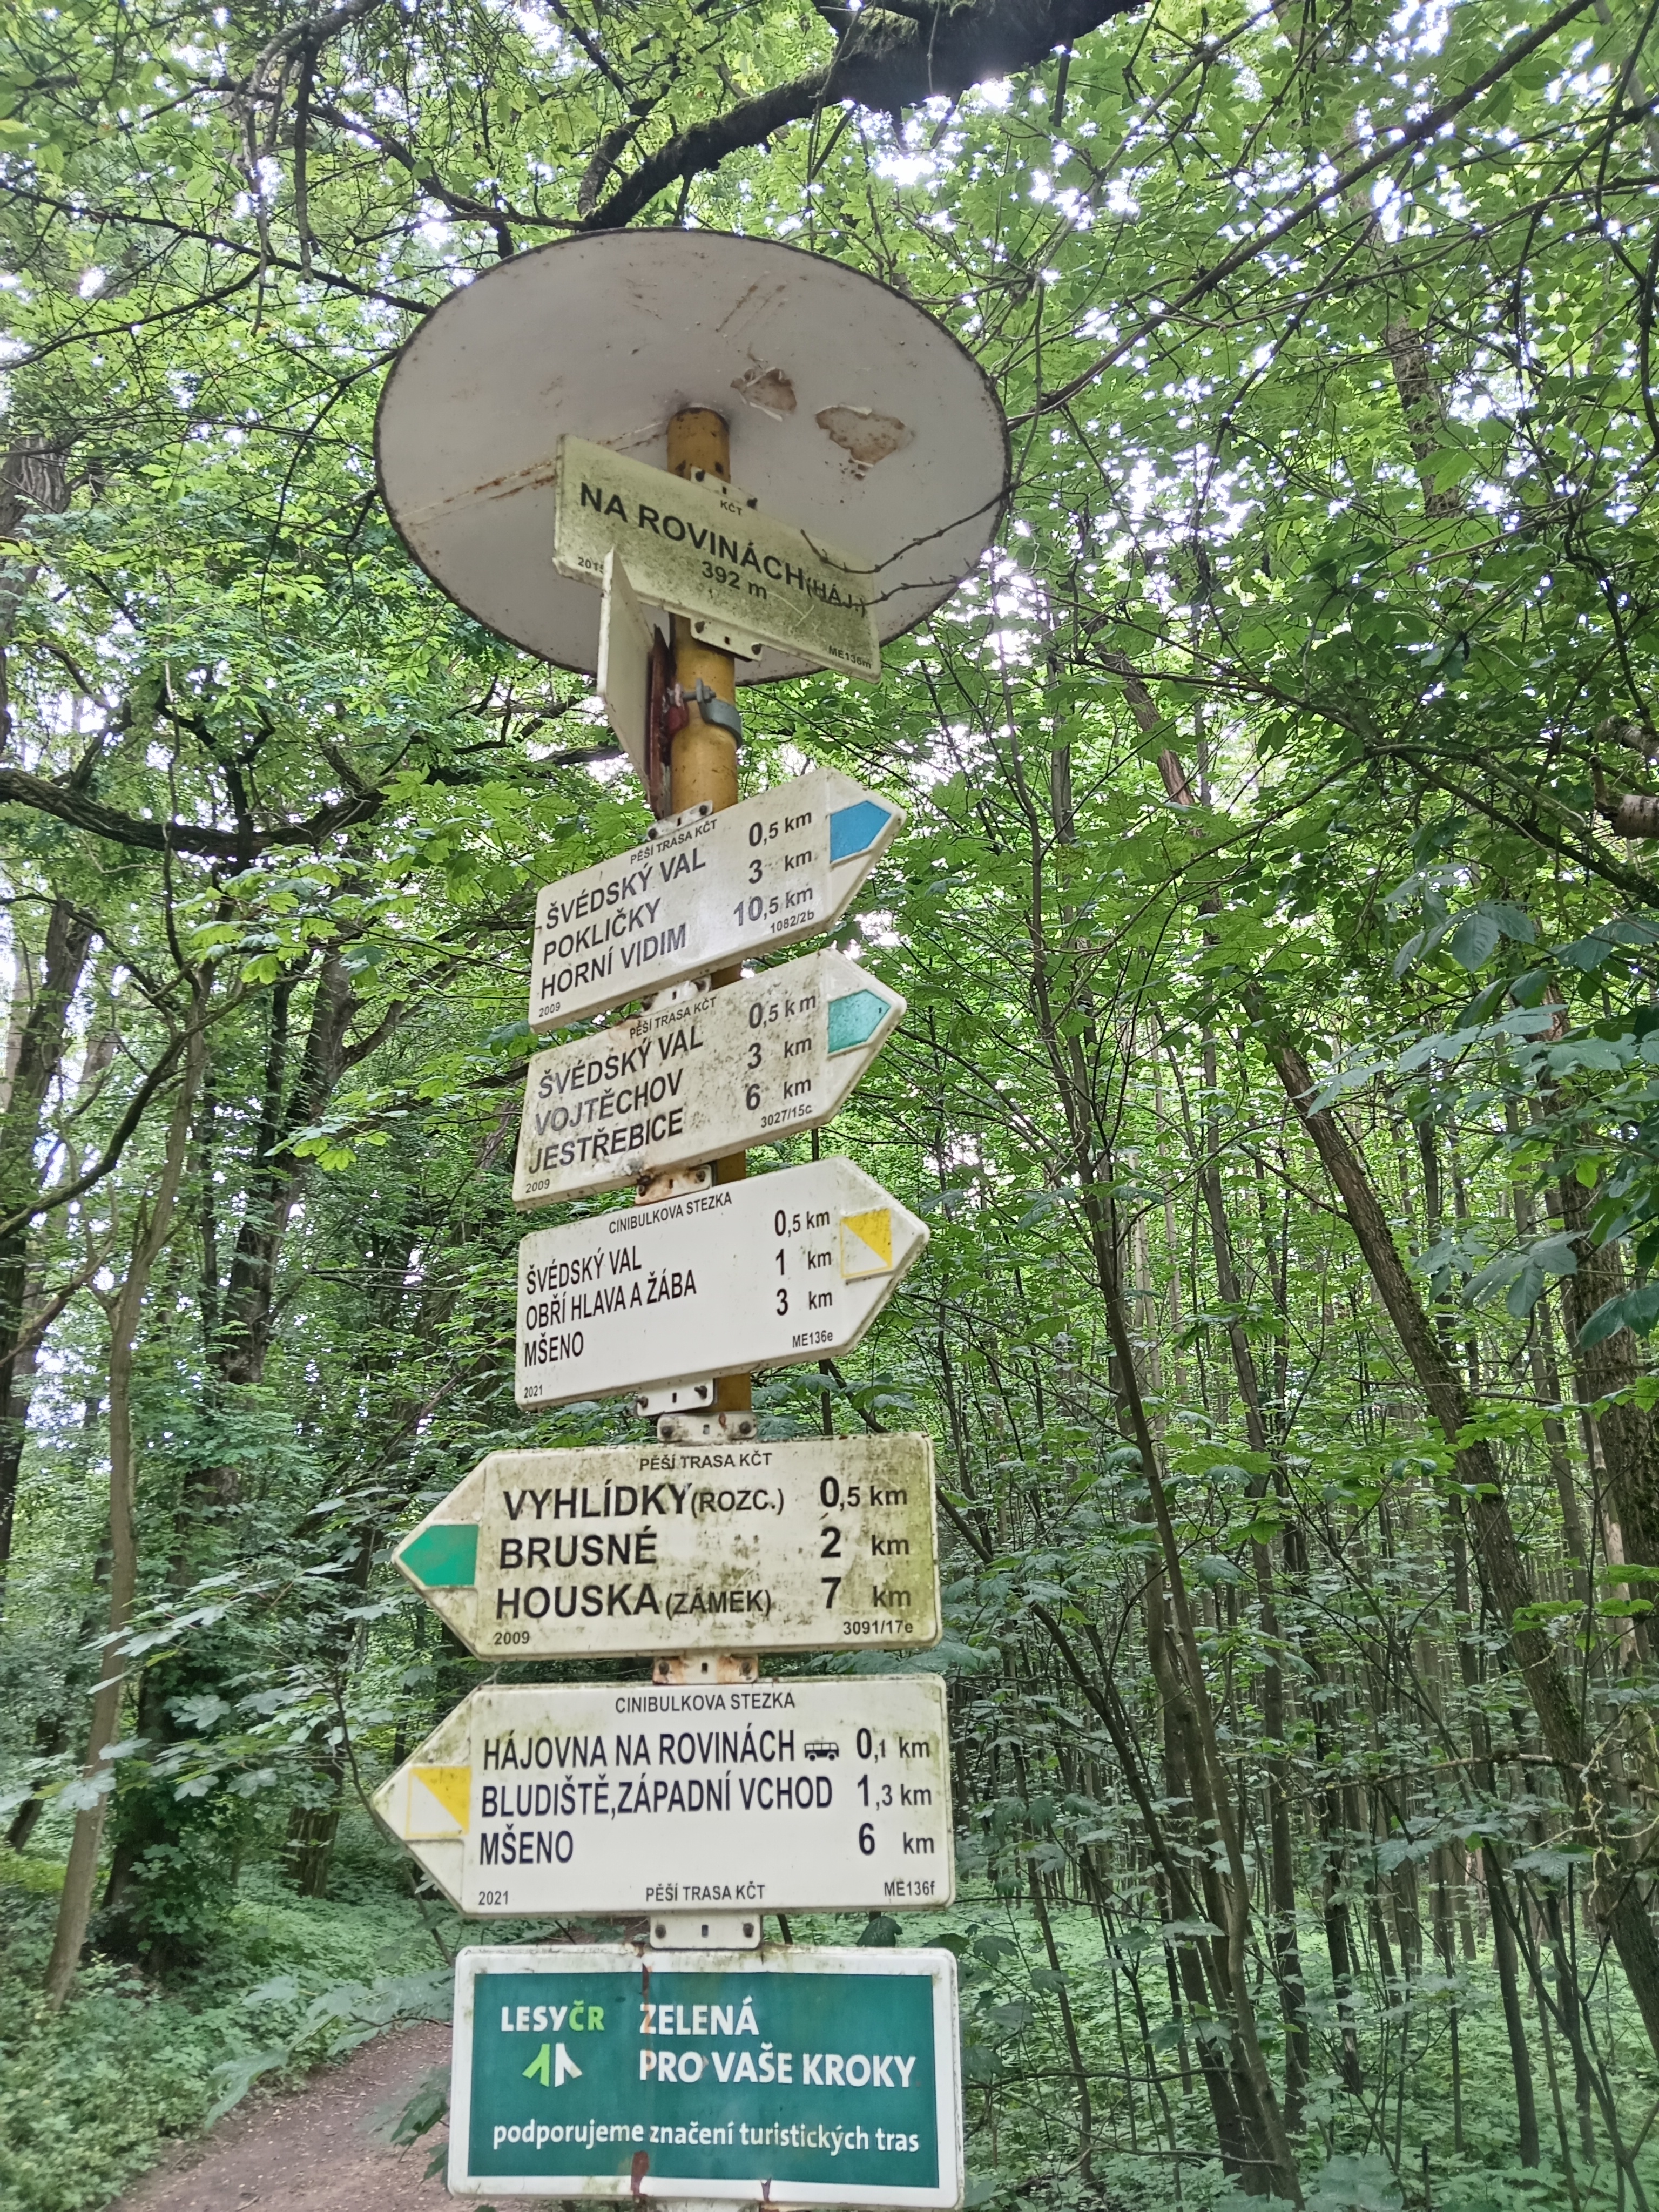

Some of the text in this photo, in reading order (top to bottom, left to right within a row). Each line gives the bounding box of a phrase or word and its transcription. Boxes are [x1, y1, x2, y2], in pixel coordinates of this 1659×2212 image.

[580, 482, 628, 523] NA
[720, 498, 743, 516] KČT
[701, 560, 767, 600] 392 m
[828, 645, 871, 669] ME136m
[630, 819, 717, 864] PĚŠÍ TRASA KČT
[546, 812, 812, 930] ŠVÉDSKÝ VAL 0,5 km
[543, 852, 812, 965] POKLIČKY 3 km
[770, 909, 814, 933] 1082/2b
[541, 887, 813, 1000] HORNÍ VIDIM 10,5 km
[538, 1002, 561, 1017] 2009
[629, 996, 717, 1040] PĚŠÍ TRASA KČT
[538, 994, 817, 1099] ŠVÉDSKÝ VAL 0,5 km
[535, 1037, 812, 1136] VOJTĚCHOV 3 km
[528, 1078, 812, 1174] JESTŘEBICE 6 km
[760, 1104, 813, 1128] 3027/15c
[525, 1178, 550, 1194] 2009
[609, 1192, 732, 1234] CINIBULKOVA STEZKA
[527, 1209, 830, 1296] ŠVÉDSKÝ VAL 0,5 km
[525, 1249, 831, 1331] OBŘÍ HLAVA A ŽÁBA 1 km
[524, 1289, 833, 1367] MŠENO 3 km
[792, 1330, 833, 1348] ME136e
[524, 1385, 543, 1399] 2021
[639, 1450, 772, 1471] PĚŠÍ TRASA KČT
[819, 1476, 861, 1512] 0,5
[870, 1485, 908, 1506] km
[500, 1525, 910, 1569] BRUSNÉ 2 km
[496, 1583, 660, 1620] HOUSKA
[822, 1577, 842, 1609] 7
[874, 1587, 911, 1608] km
[494, 1631, 530, 1645] 2009
[843, 1620, 913, 1635] 3091/17e
[615, 1691, 795, 1714] CINIBULKOVA STEZKA
[483, 1727, 930, 1771] HÁJOVNA NA ROVINÁCH 0,1 km
[739, 1777, 833, 1810] VCHOD
[857, 1775, 893, 1812] 1,3
[901, 1784, 932, 1806] km
[480, 1823, 934, 1865] MŠENO 6 km
[478, 1891, 509, 1905] 2021
[646, 1881, 765, 1901] PĚŠÍ TRASA KČT
[883, 1880, 935, 1896] ME136f
[639, 1996, 759, 2035] ZELENÁ
[639, 2042, 916, 2088] PRO VAŠE KROKY
[494, 2119, 919, 2156] podporujeme značení turistických tras
